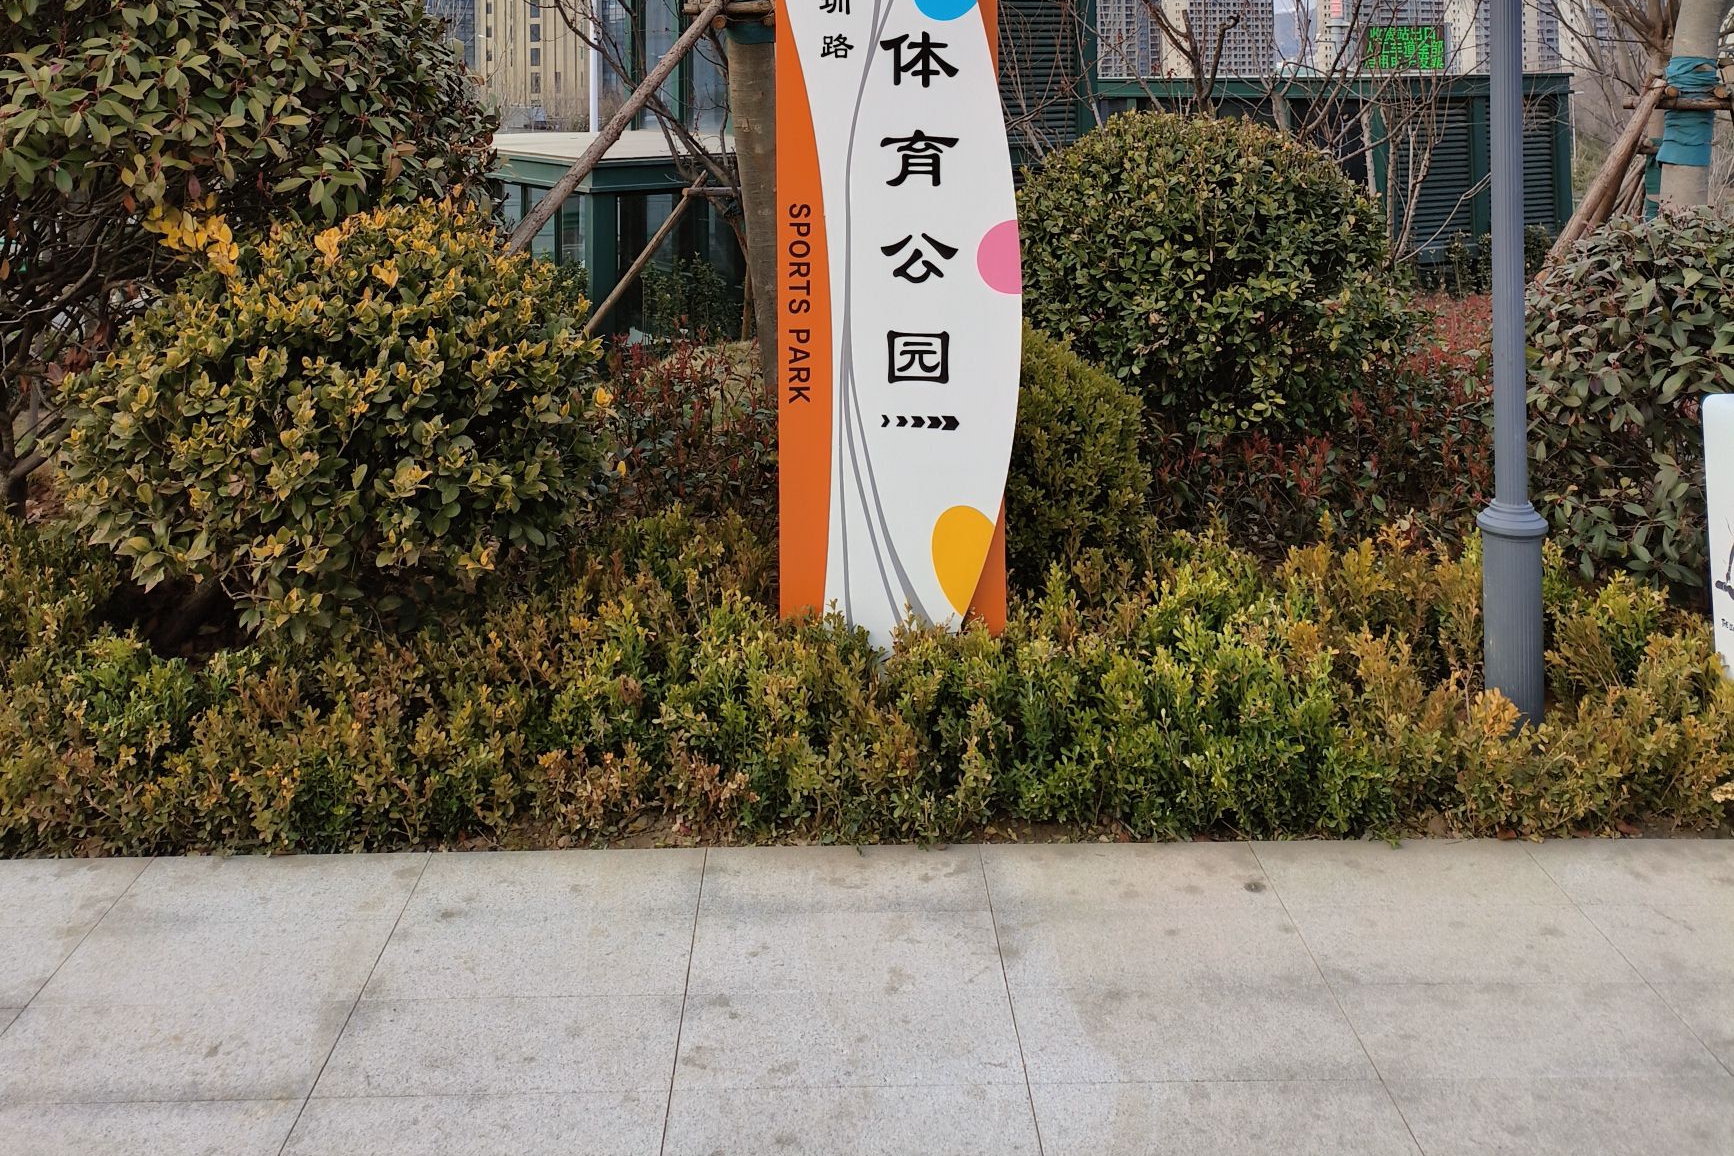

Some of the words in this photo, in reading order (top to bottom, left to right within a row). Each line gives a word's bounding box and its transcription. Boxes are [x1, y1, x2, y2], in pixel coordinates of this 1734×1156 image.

[788, 203, 811, 314] SPORTS
[879, 30, 960, 385] 体育公园
[788, 328, 811, 404] PARK
